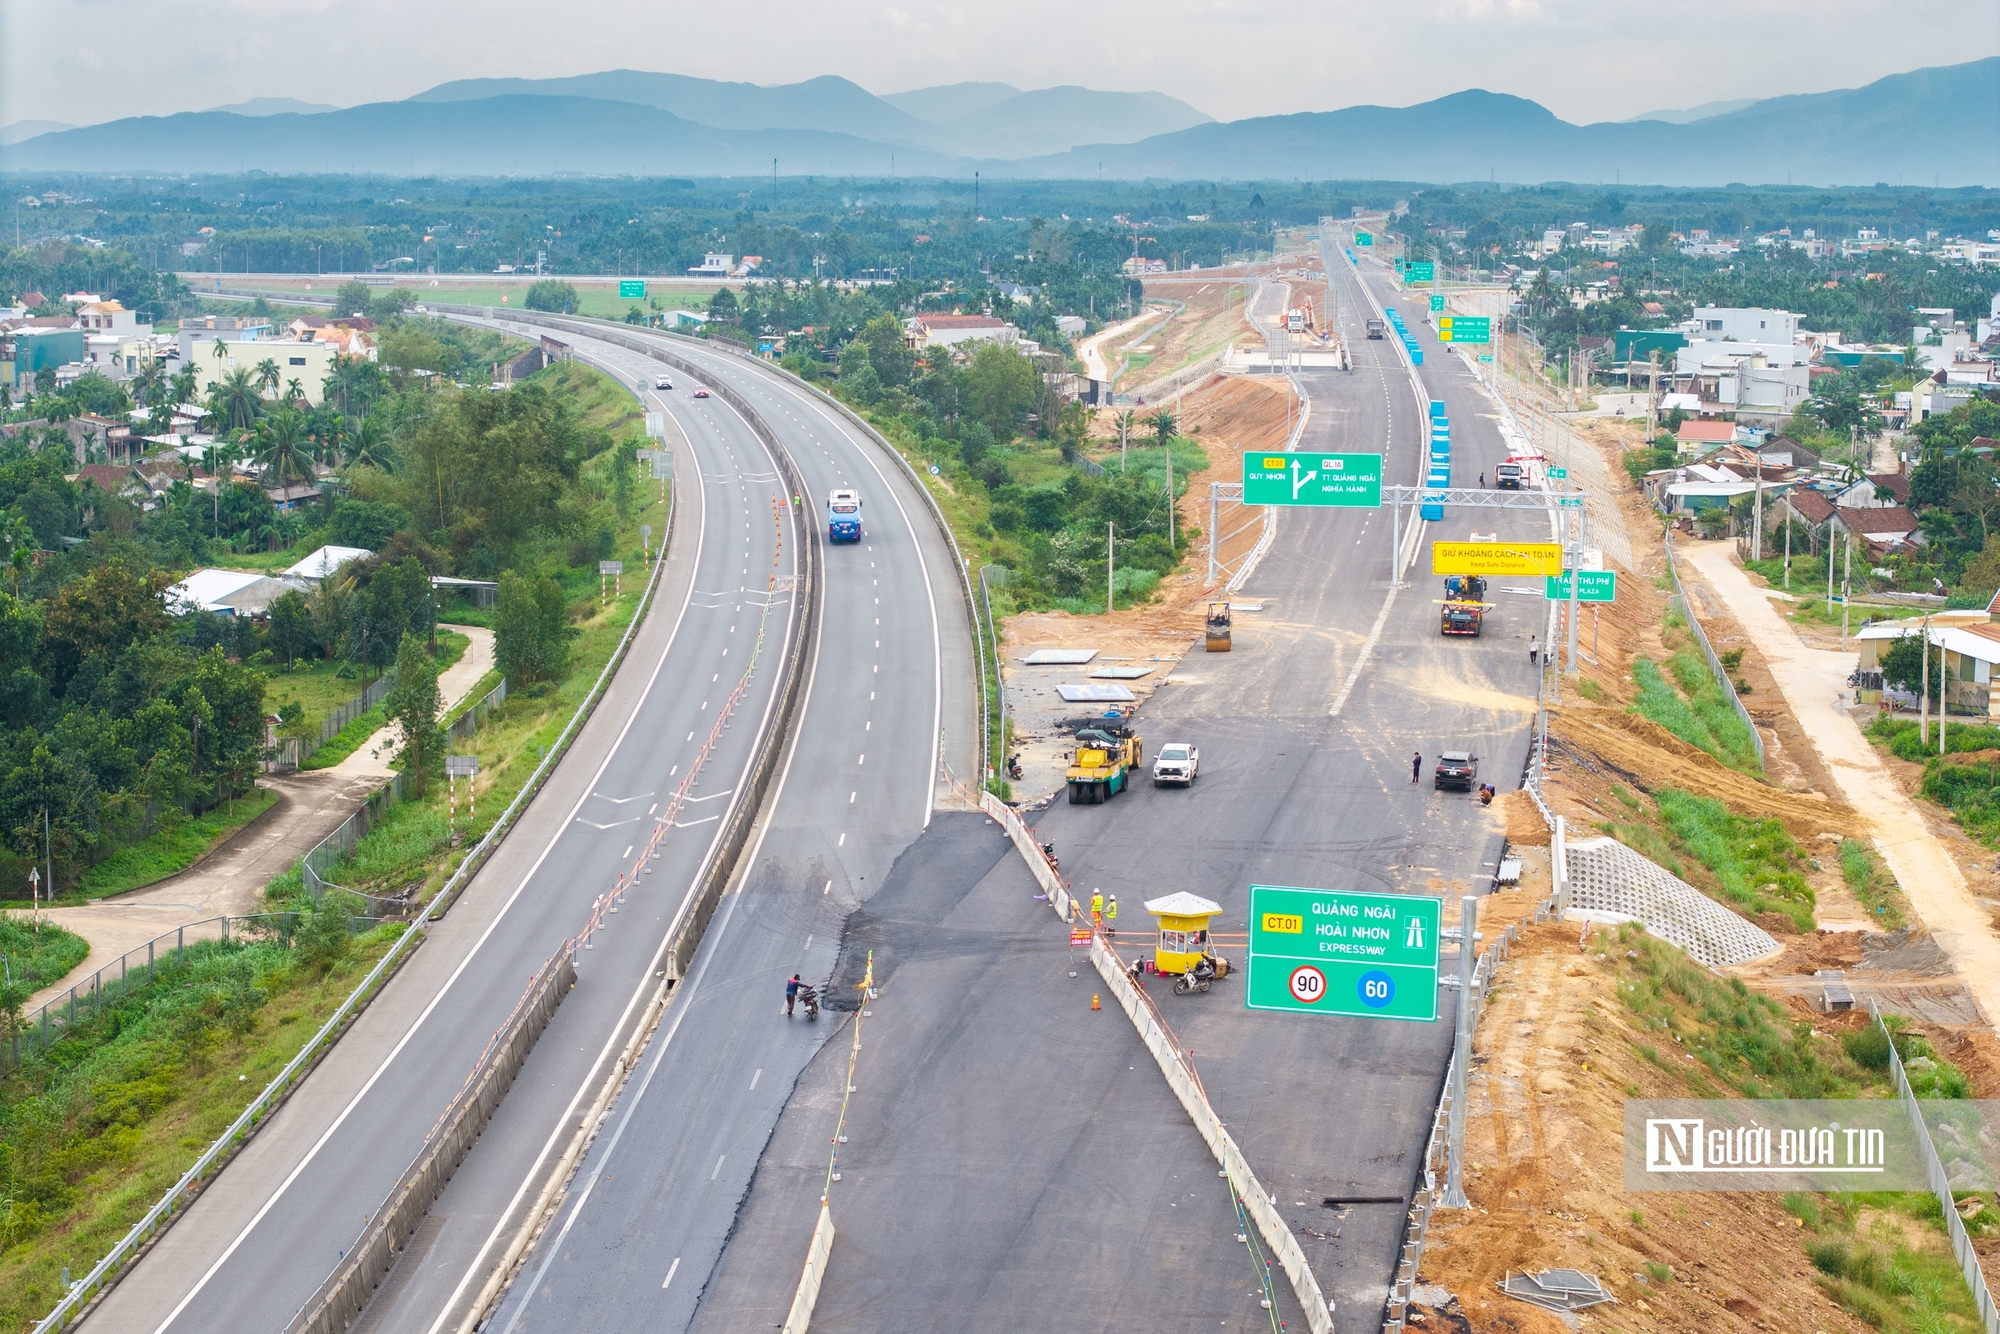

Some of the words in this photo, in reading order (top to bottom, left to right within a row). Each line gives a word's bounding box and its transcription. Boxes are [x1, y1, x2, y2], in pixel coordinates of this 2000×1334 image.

[1333, 472, 1357, 482] QUẢNG
[1359, 474, 1376, 482] NGÃI
[1322, 484, 1343, 492] NGHĨA
[1346, 484, 1367, 493] HÀNH
[1442, 547, 1456, 557] GIỮ
[1458, 547, 1493, 558] KHOẢNG
[1494, 548, 1516, 558] CÁCH
[1533, 549, 1554, 558] TOÀN
[1578, 577, 1595, 585] THU
[1596, 576, 1610, 585] PHÍ
[1312, 899, 1359, 918] QUẢNG
[1364, 904, 1396, 920] NGÃI
[1267, 918, 1297, 931] CT.01
[1315, 921, 1347, 938] HOÀI
[1352, 926, 1390, 940] NHƠN
[1319, 942, 1386, 956] EXPRESSWAY
[1297, 976, 1318, 993] 90
[1365, 980, 1388, 998] 60
